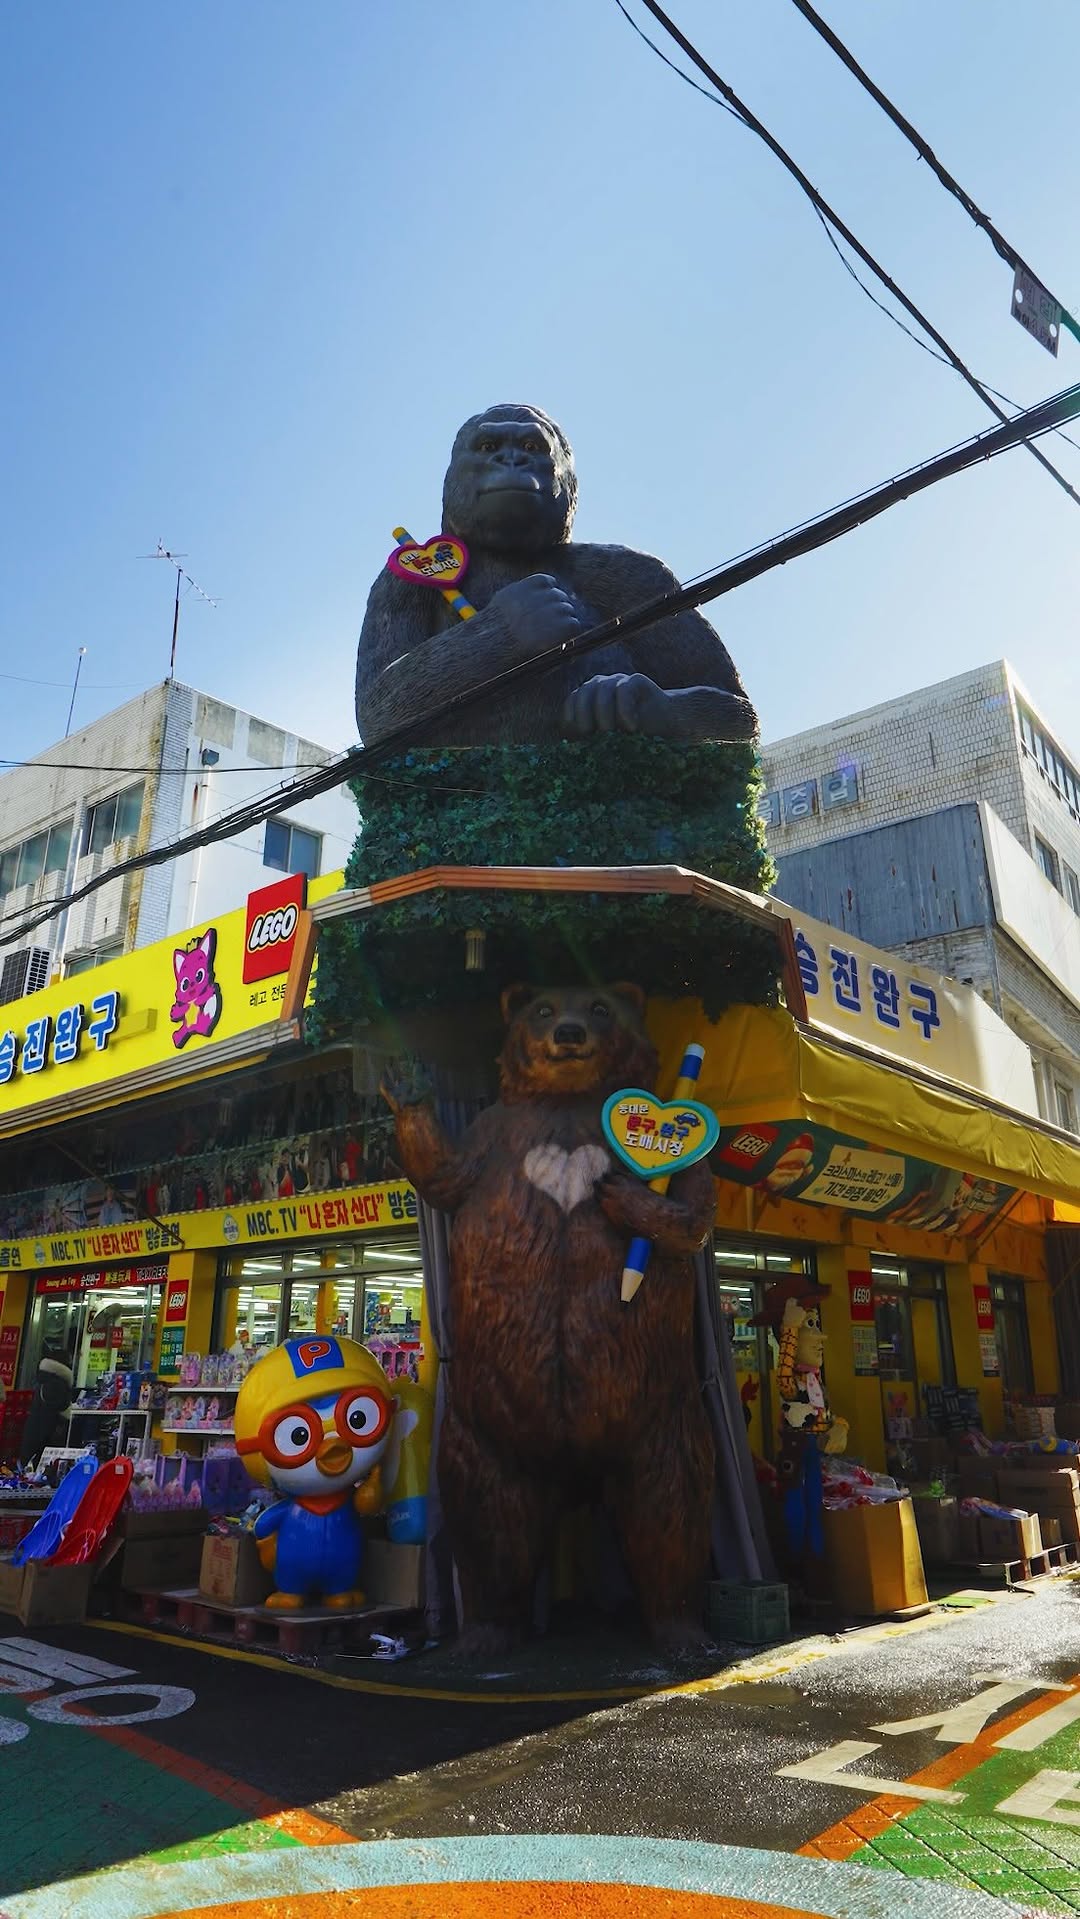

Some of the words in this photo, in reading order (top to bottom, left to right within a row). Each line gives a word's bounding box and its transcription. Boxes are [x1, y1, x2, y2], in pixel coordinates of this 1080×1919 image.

[248, 904, 298, 952] LEGO
[250, 991, 267, 1006] 레고
[0, 991, 119, 1084] 승진완구
[624, 1131, 684, 1157] 도매시장
[730, 1133, 772, 1157] LEGO
[279, 1206, 297, 1233] TV
[74, 1237, 87, 1258] TV
[169, 1292, 187, 1309] LEGO
[853, 1287, 871, 1305] LEGO
[978, 1298, 991, 1315] LEGO
[3, 1331, 18, 1343] TAX
[297, 1340, 332, 1369] P
